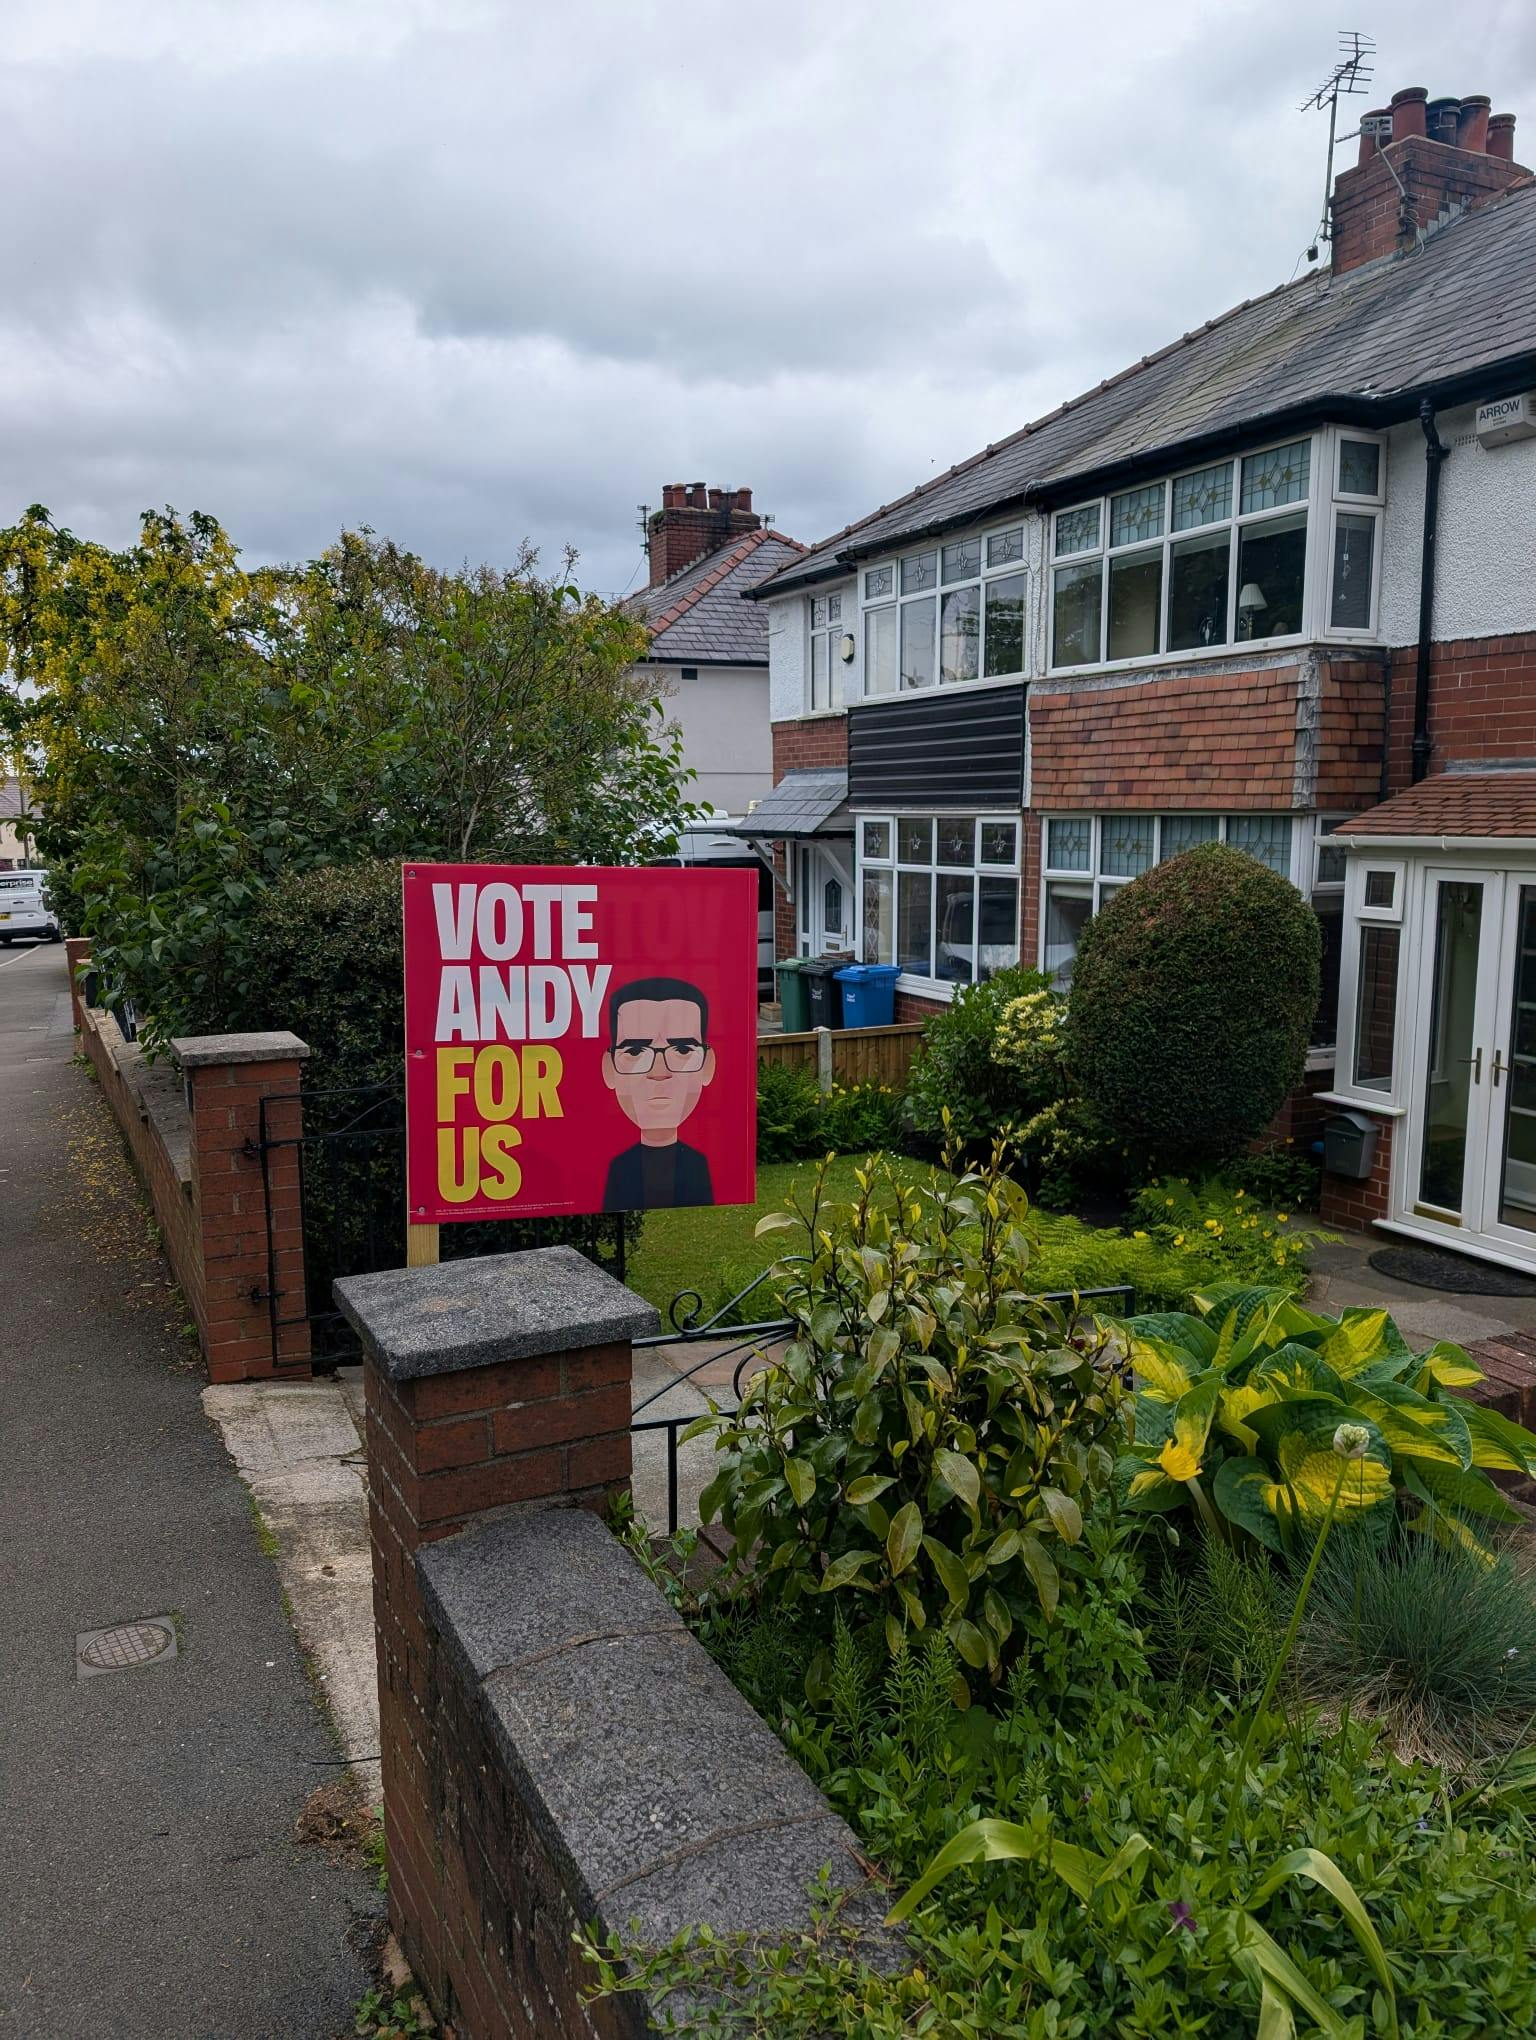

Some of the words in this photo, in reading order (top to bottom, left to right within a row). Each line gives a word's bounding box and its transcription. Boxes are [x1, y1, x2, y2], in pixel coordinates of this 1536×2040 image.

[1480, 400, 1520, 421] ARROW
[432, 883, 598, 961] VOTE
[434, 965, 612, 1042] ANDY
[436, 1045, 564, 1122] FOR
[437, 1124, 522, 1203] US
